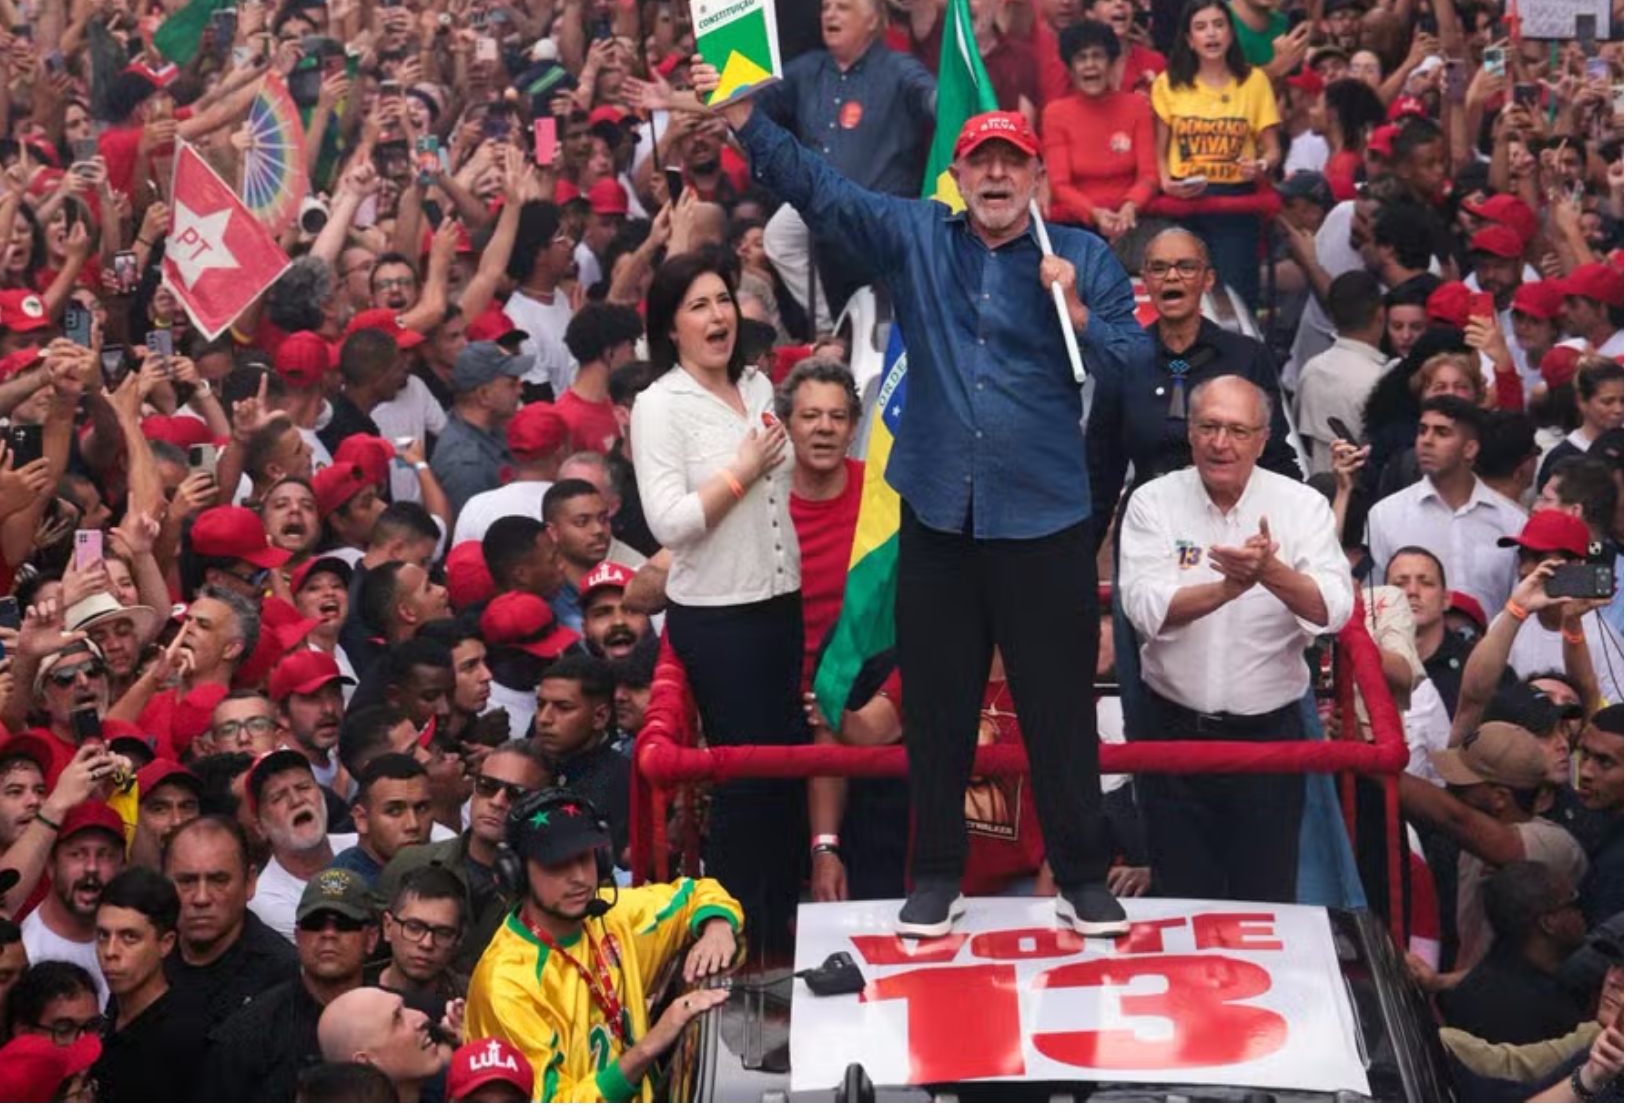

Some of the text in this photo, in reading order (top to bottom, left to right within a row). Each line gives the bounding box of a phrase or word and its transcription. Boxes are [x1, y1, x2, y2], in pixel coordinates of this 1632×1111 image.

[175, 225, 214, 262] PT
[1176, 546, 1202, 566] 13
[589, 568, 624, 586] LULA
[849, 912, 1286, 966] VOTE
[858, 953, 1289, 1086] 13
[470, 1049, 519, 1072] LULA
